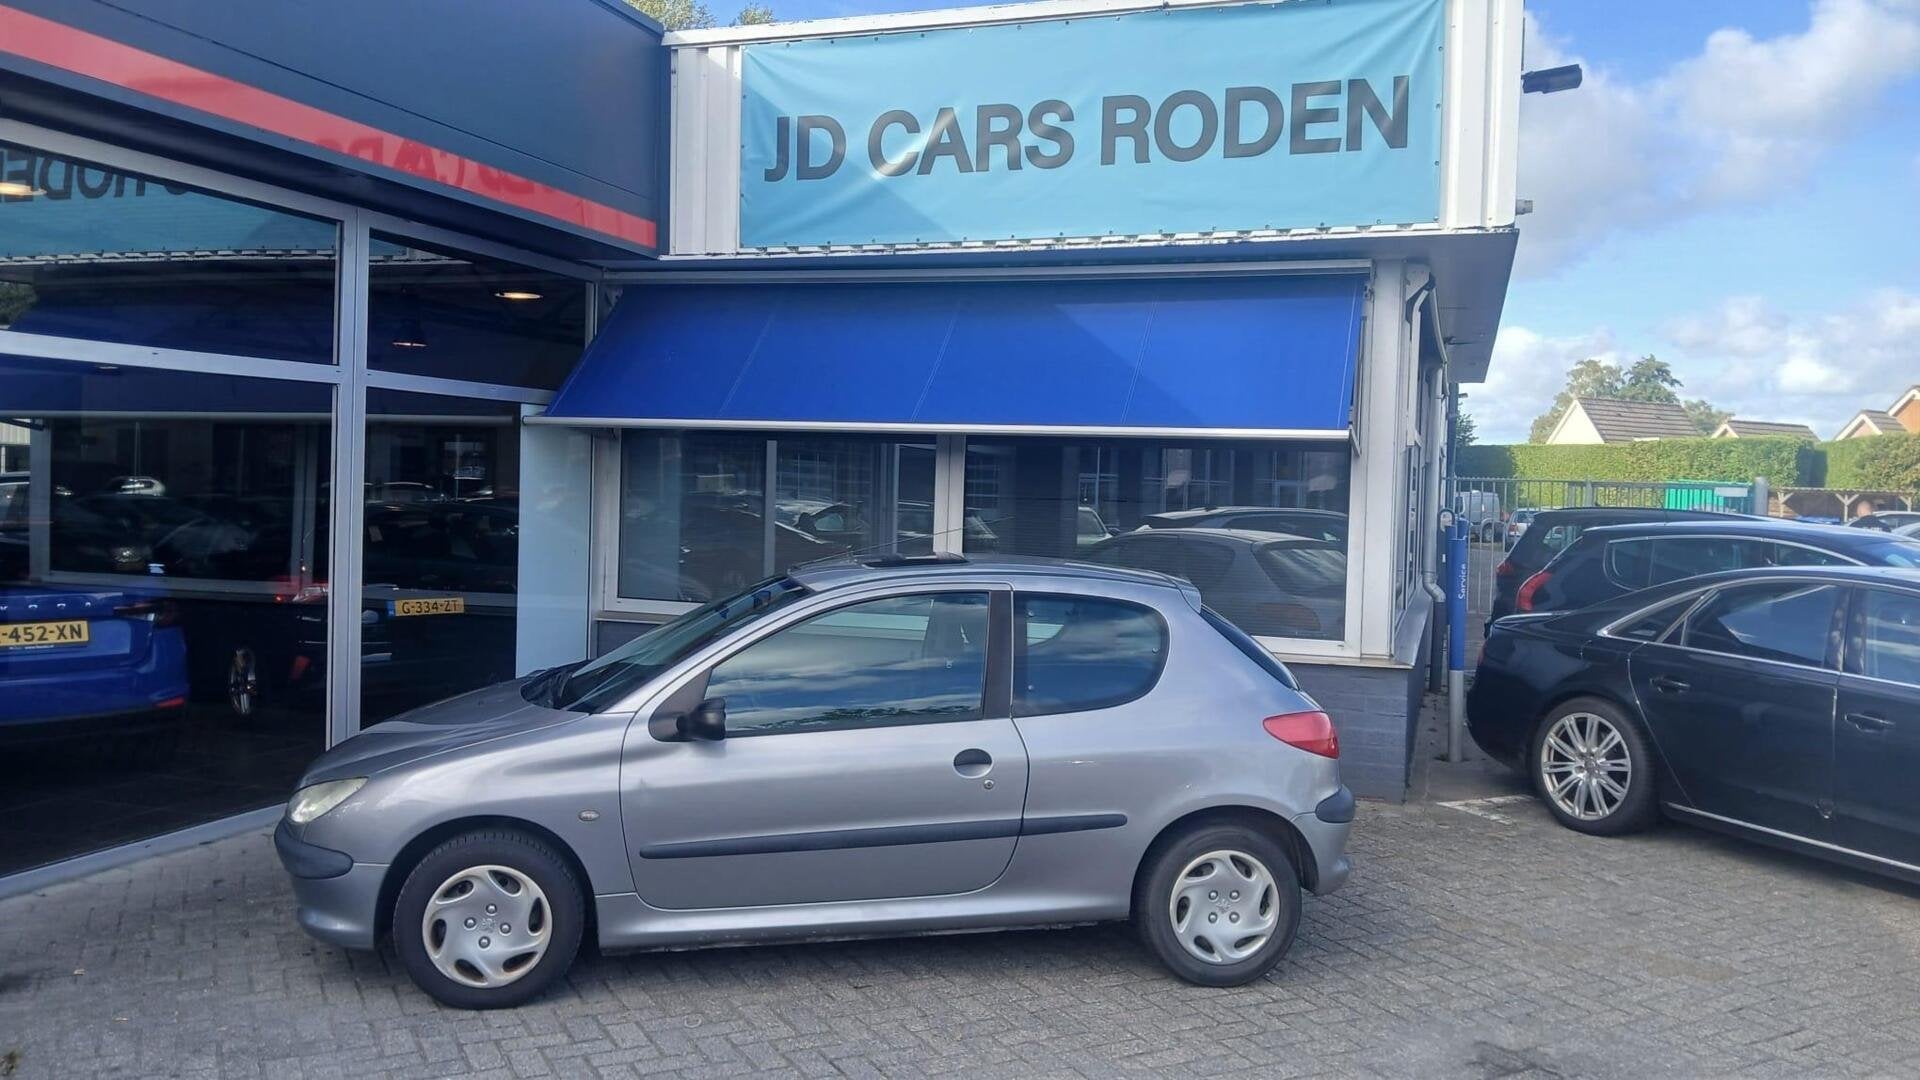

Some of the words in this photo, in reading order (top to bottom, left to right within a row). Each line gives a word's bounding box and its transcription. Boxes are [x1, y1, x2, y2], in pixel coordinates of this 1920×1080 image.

[764, 115, 847, 182] JD
[868, 99, 1075, 177] CARS
[1100, 75, 1410, 166] RODEN
[1457, 563, 1467, 600] Service
[401, 600, 458, 615] G-334-ZT
[0, 623, 83, 643] -452-XN
